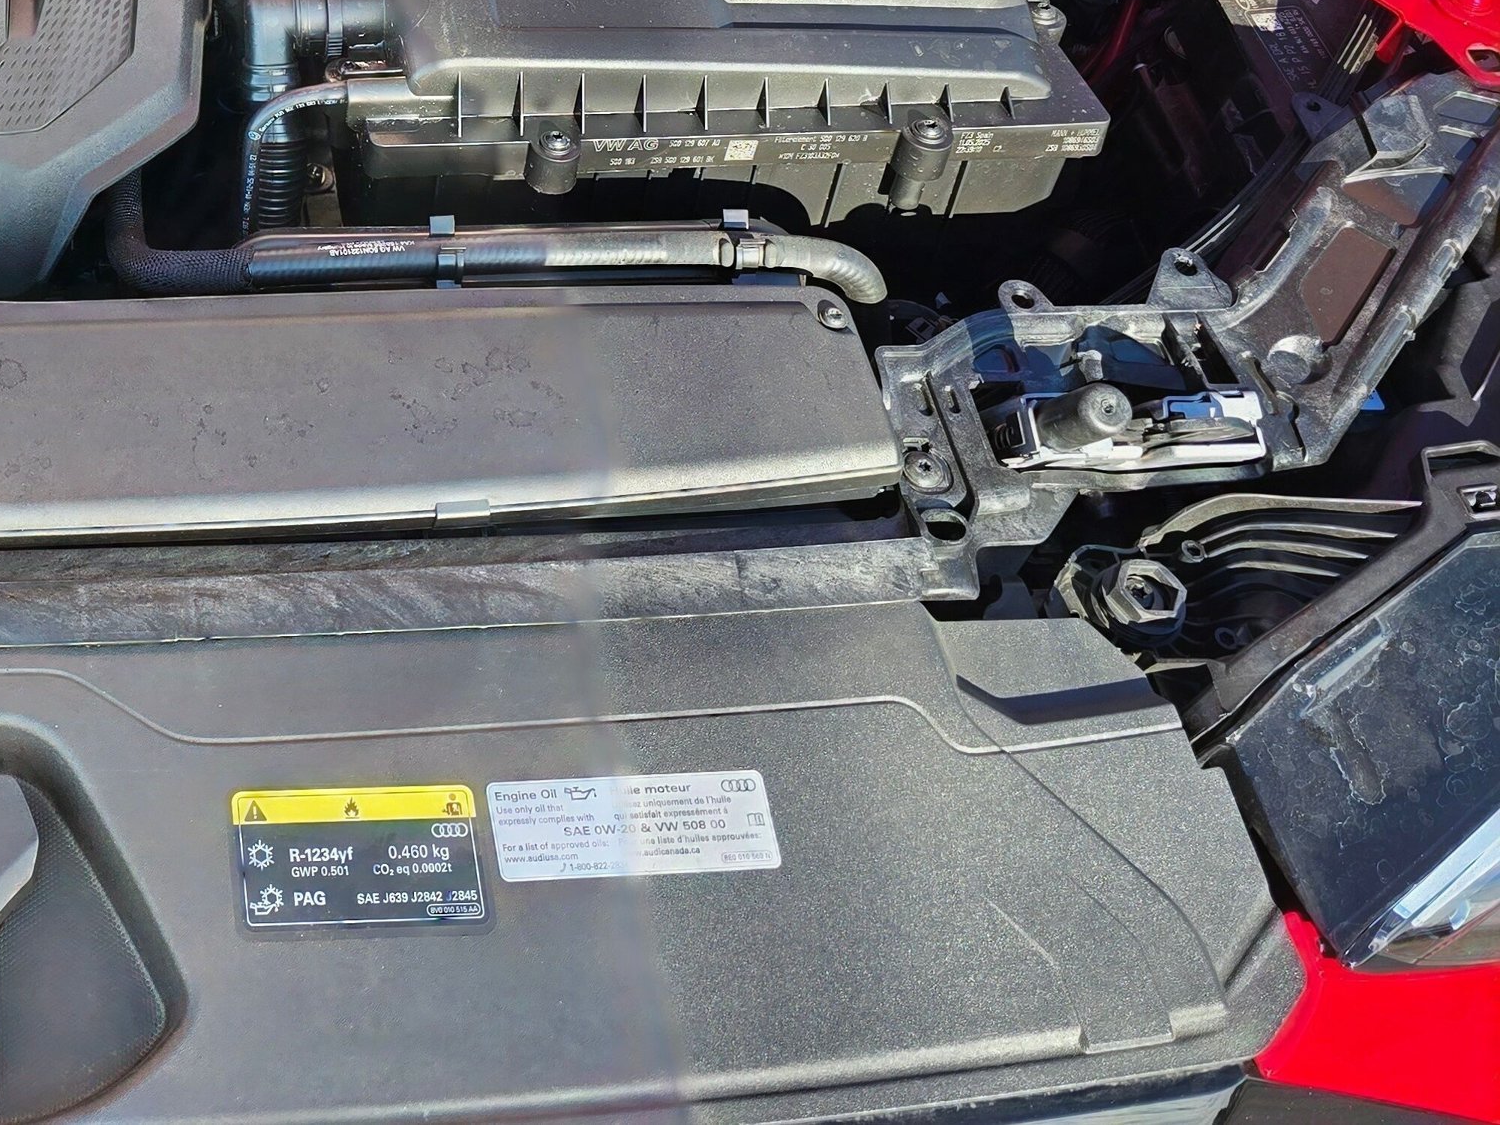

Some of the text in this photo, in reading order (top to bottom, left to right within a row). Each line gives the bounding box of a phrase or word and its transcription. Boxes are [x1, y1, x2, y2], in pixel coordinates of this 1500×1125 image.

[1050, 129, 1068, 137] MANN
[592, 138, 627, 152] VW
[627, 138, 659, 151] AG
[644, 783, 691, 794] moteur
[495, 789, 557, 803] Engine Oil
[643, 795, 731, 808] uniquement de l'huile
[496, 803, 564, 815] Use only oil that
[614, 812, 627, 821] qui
[629, 810, 662, 819] satisfait
[663, 807, 721, 818] expressément
[498, 813, 594, 827] expressly complies with
[564, 818, 726, 837] SAE 0W-20 & VW 508 00
[640, 837, 656, 845] une
[657, 835, 675, 844] liste
[677, 834, 710, 843] d'huiles
[711, 832, 761, 843] approuvées:
[503, 844, 516, 852] For
[526, 843, 539, 851] list
[541, 842, 548, 850] of
[551, 842, 590, 852] approved
[592, 841, 609, 850] oils:
[289, 844, 450, 864] R-1234yf 0.460 kg
[504, 854, 578, 863] www.audiusa.com
[291, 866, 318, 878] GWP
[321, 865, 349, 877] 0.501
[396, 865, 410, 875] eq
[412, 863, 452, 875] 0.0002t
[293, 890, 477, 906] PAG SAE J639 J2842 J2845
[443, 905, 454, 913] 010
[455, 905, 466, 913] 515
